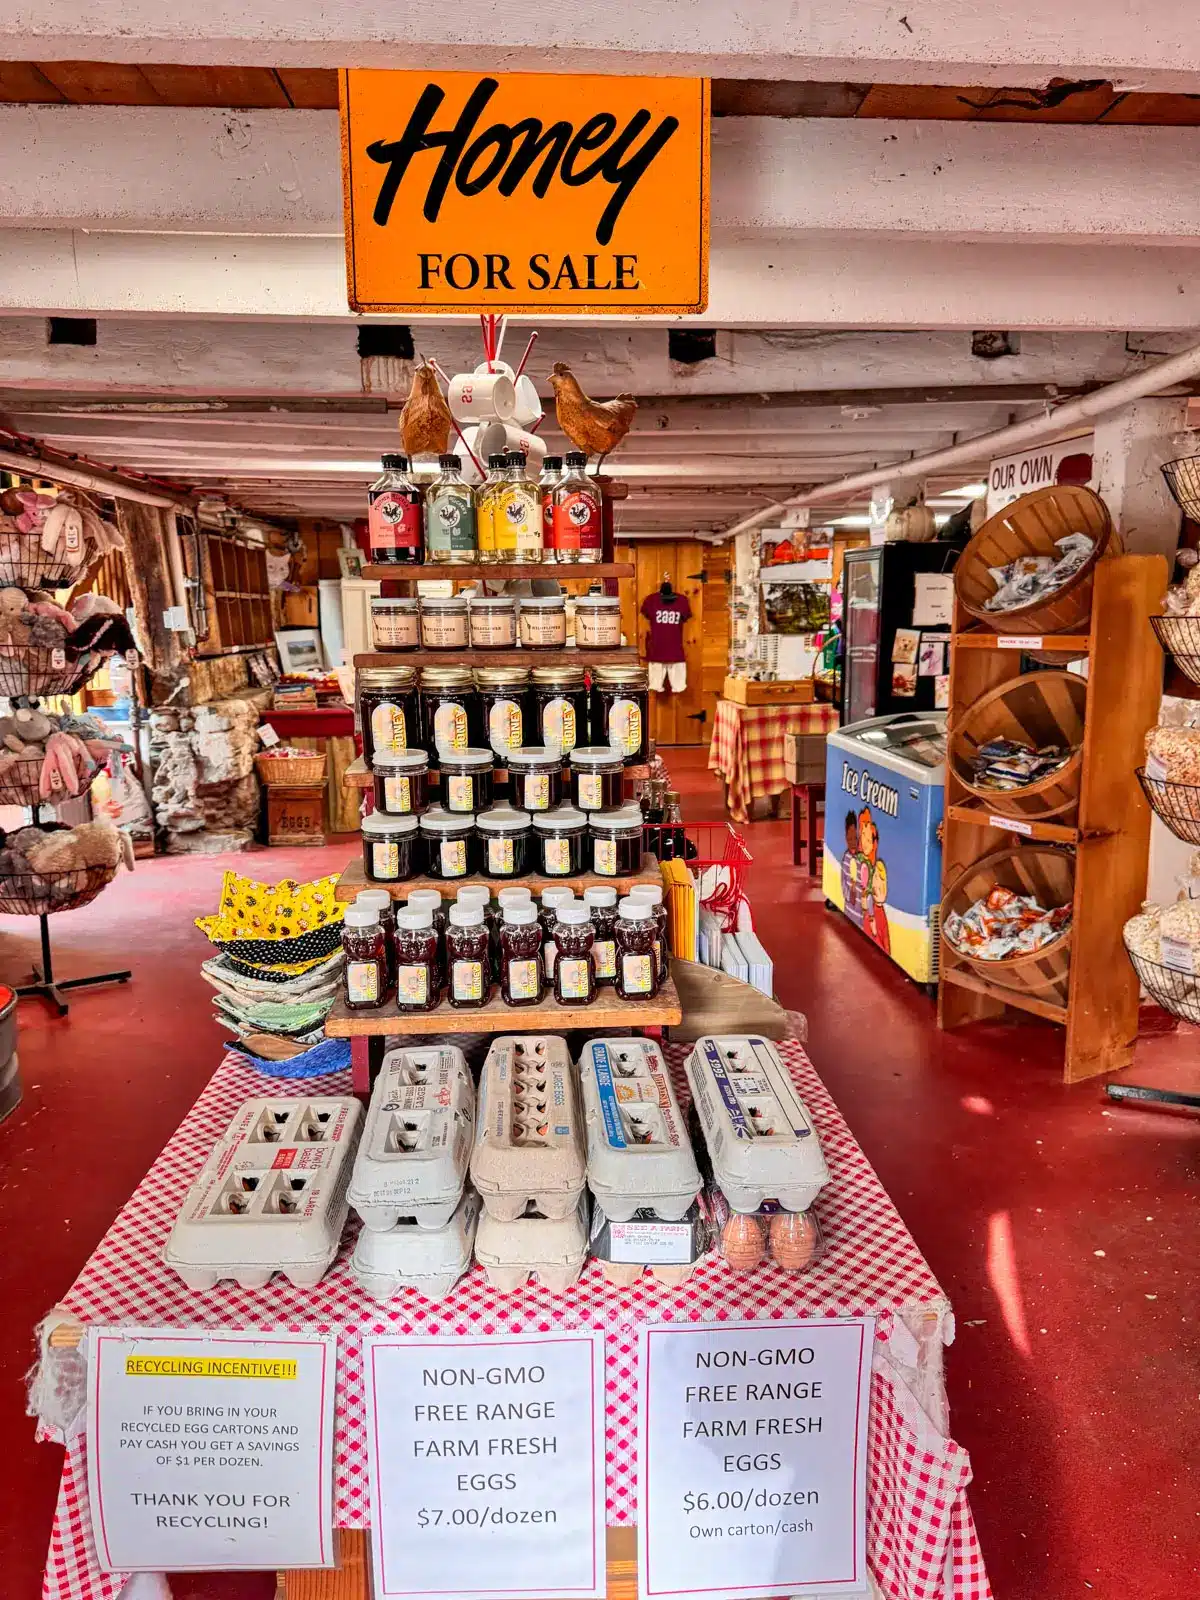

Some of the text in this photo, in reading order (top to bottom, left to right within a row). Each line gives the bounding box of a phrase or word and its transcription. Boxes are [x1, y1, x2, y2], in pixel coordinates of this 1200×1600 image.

[366, 77, 679, 246] Honey
[417, 253, 640, 290] FOR SALE
[992, 454, 1053, 491] OUR OWN
[393, 709, 405, 750] HONEY
[455, 709, 467, 749] HONEY
[510, 708, 521, 748] HONEY
[563, 707, 574, 747] HONEY
[629, 708, 640, 747] HONEY
[841, 760, 899, 819] Ice Cream
[599, 1069, 611, 1087] LARGE
[709, 1058, 726, 1079] EGGS
[415, 1086, 426, 1109] LARGE
[553, 1071, 565, 1106] LARGE EGGS
[303, 1196, 318, 1217] LARGE
[126, 1360, 297, 1376] RECYCLING INCENTIVE!!!
[696, 1347, 815, 1369] NON-GMO
[423, 1365, 545, 1387] NON-GMO
[685, 1381, 823, 1403] FREE RANGE
[143, 1406, 277, 1418] IF YOU BRING IN YOUR
[414, 1401, 556, 1422] FREE RANGE
[121, 1422, 298, 1435] RECYCLED EGG CARTONS AND
[683, 1416, 823, 1439] FARM FRESH
[120, 1439, 300, 1452] PAY CASH YOU GET A SAVINGS
[414, 1436, 557, 1457] FARM FRESH
[156, 1455, 263, 1467] OF $1 PER DOZEN.
[724, 1453, 782, 1473] EGGS
[457, 1473, 517, 1491] EGGS
[130, 1493, 291, 1508] THANK YOU FOR
[683, 1488, 819, 1514] $6.00/dozen
[156, 1515, 268, 1529] RECYCLING!
[417, 1506, 557, 1529] $7.00/dozen
[689, 1519, 813, 1538] Own carton/cash
